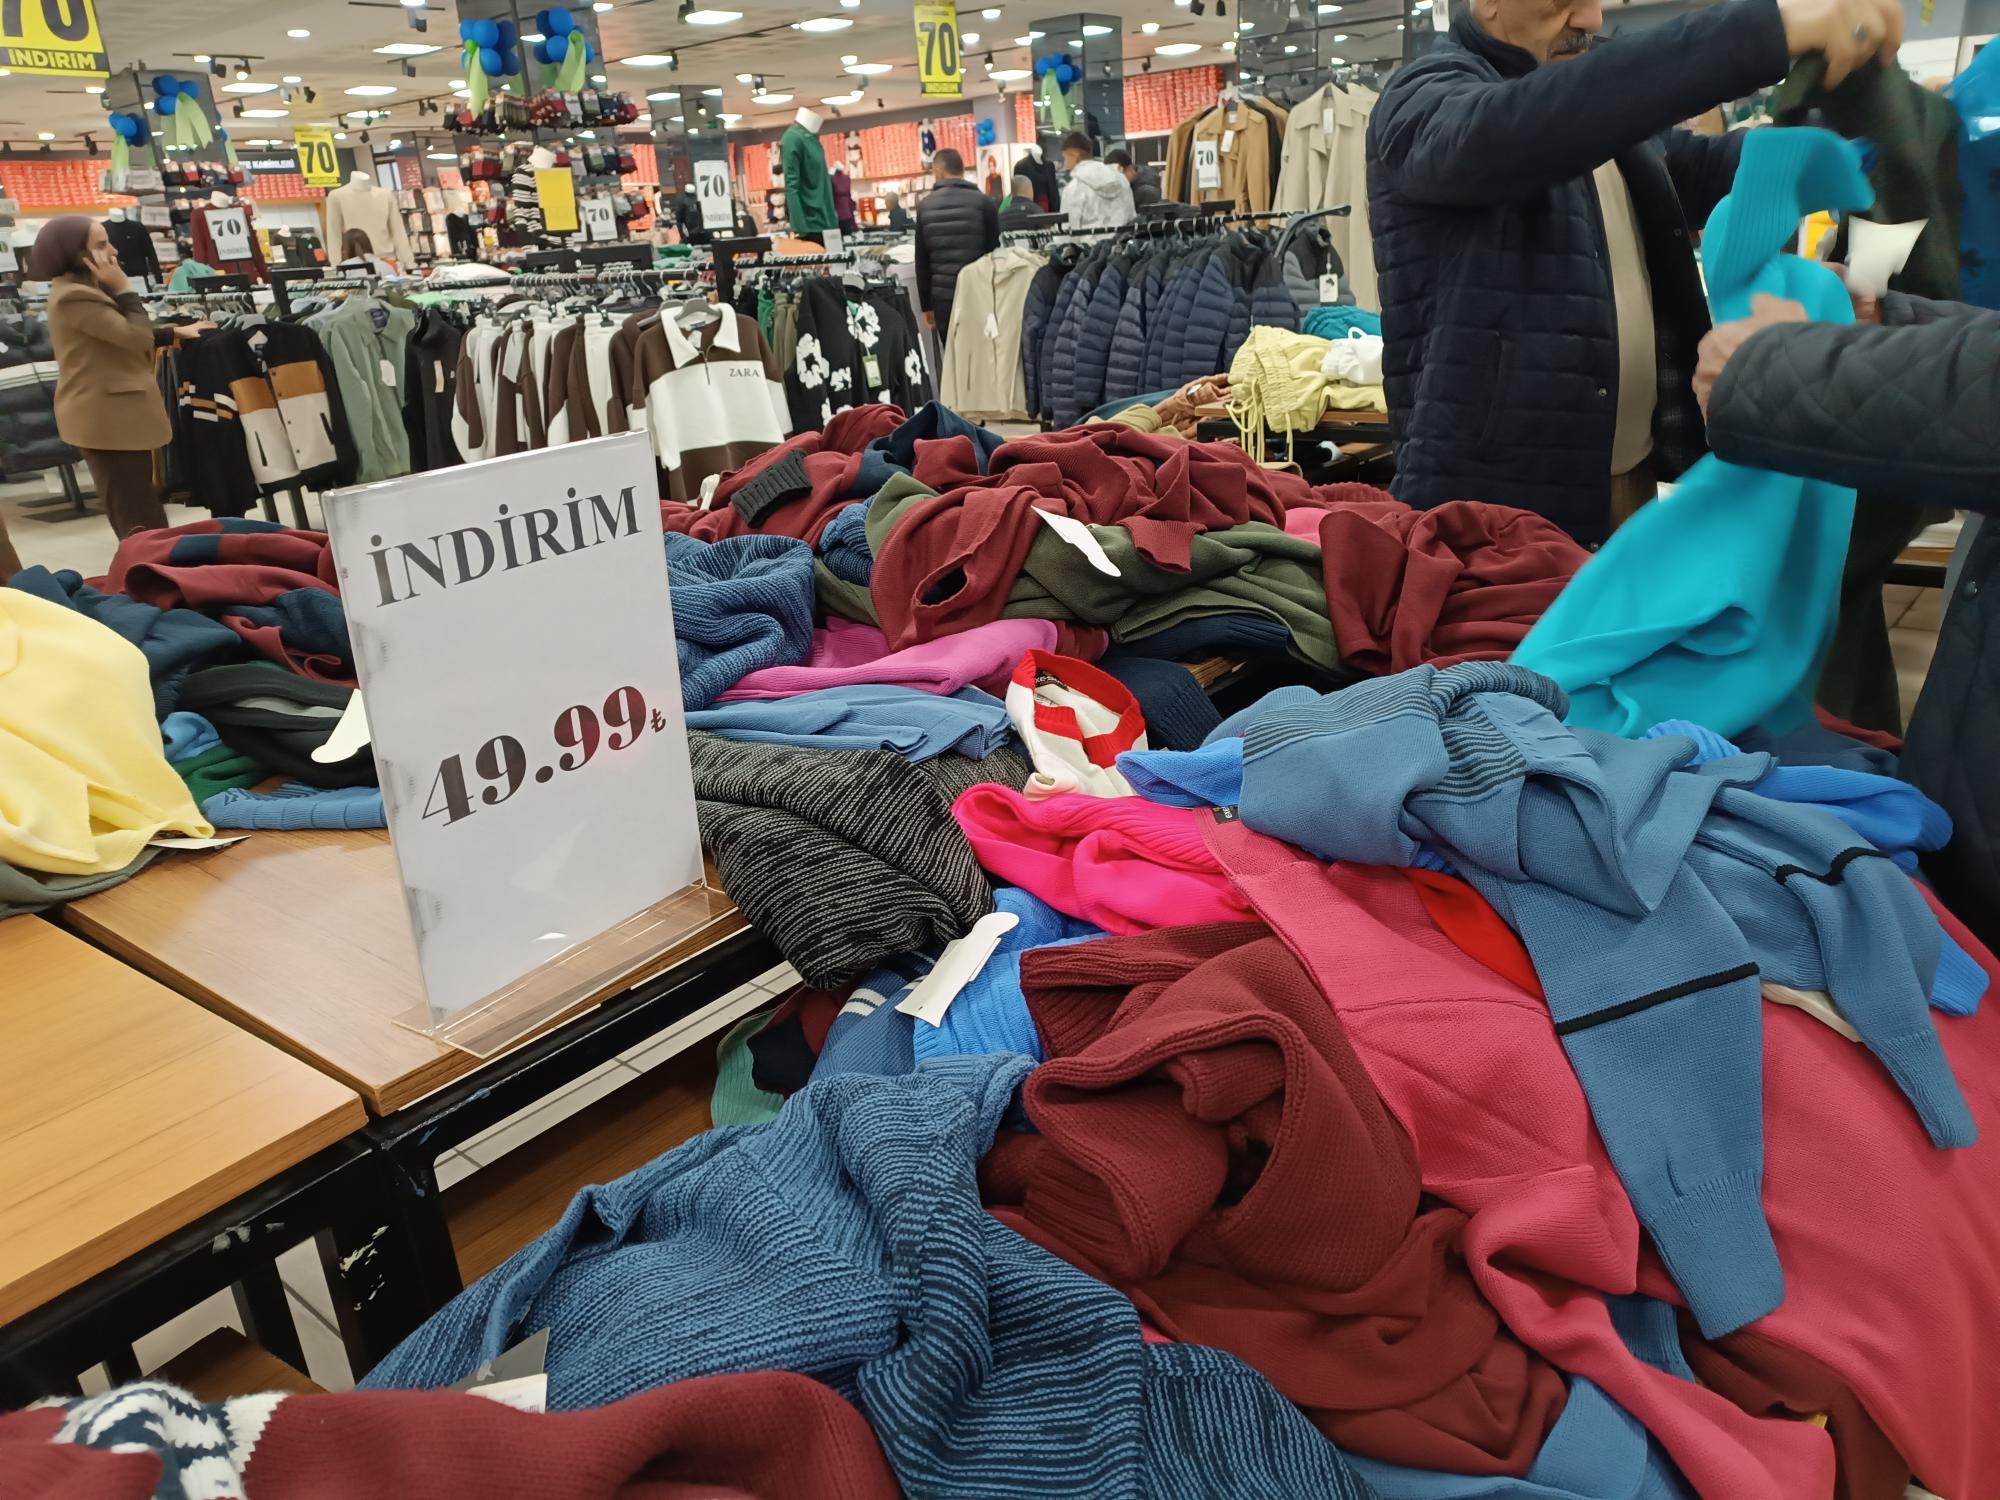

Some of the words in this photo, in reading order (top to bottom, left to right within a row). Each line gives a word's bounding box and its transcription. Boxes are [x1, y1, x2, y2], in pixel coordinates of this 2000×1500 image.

[919, 21, 957, 76] 70
[300, 141, 335, 174] 70
[1197, 150, 1214, 166] 70
[700, 174, 725, 198] 70
[588, 207, 609, 222] 70
[211, 218, 241, 237] 70
[729, 367, 760, 377] ZARA
[365, 485, 643, 608] İNDİRİM
